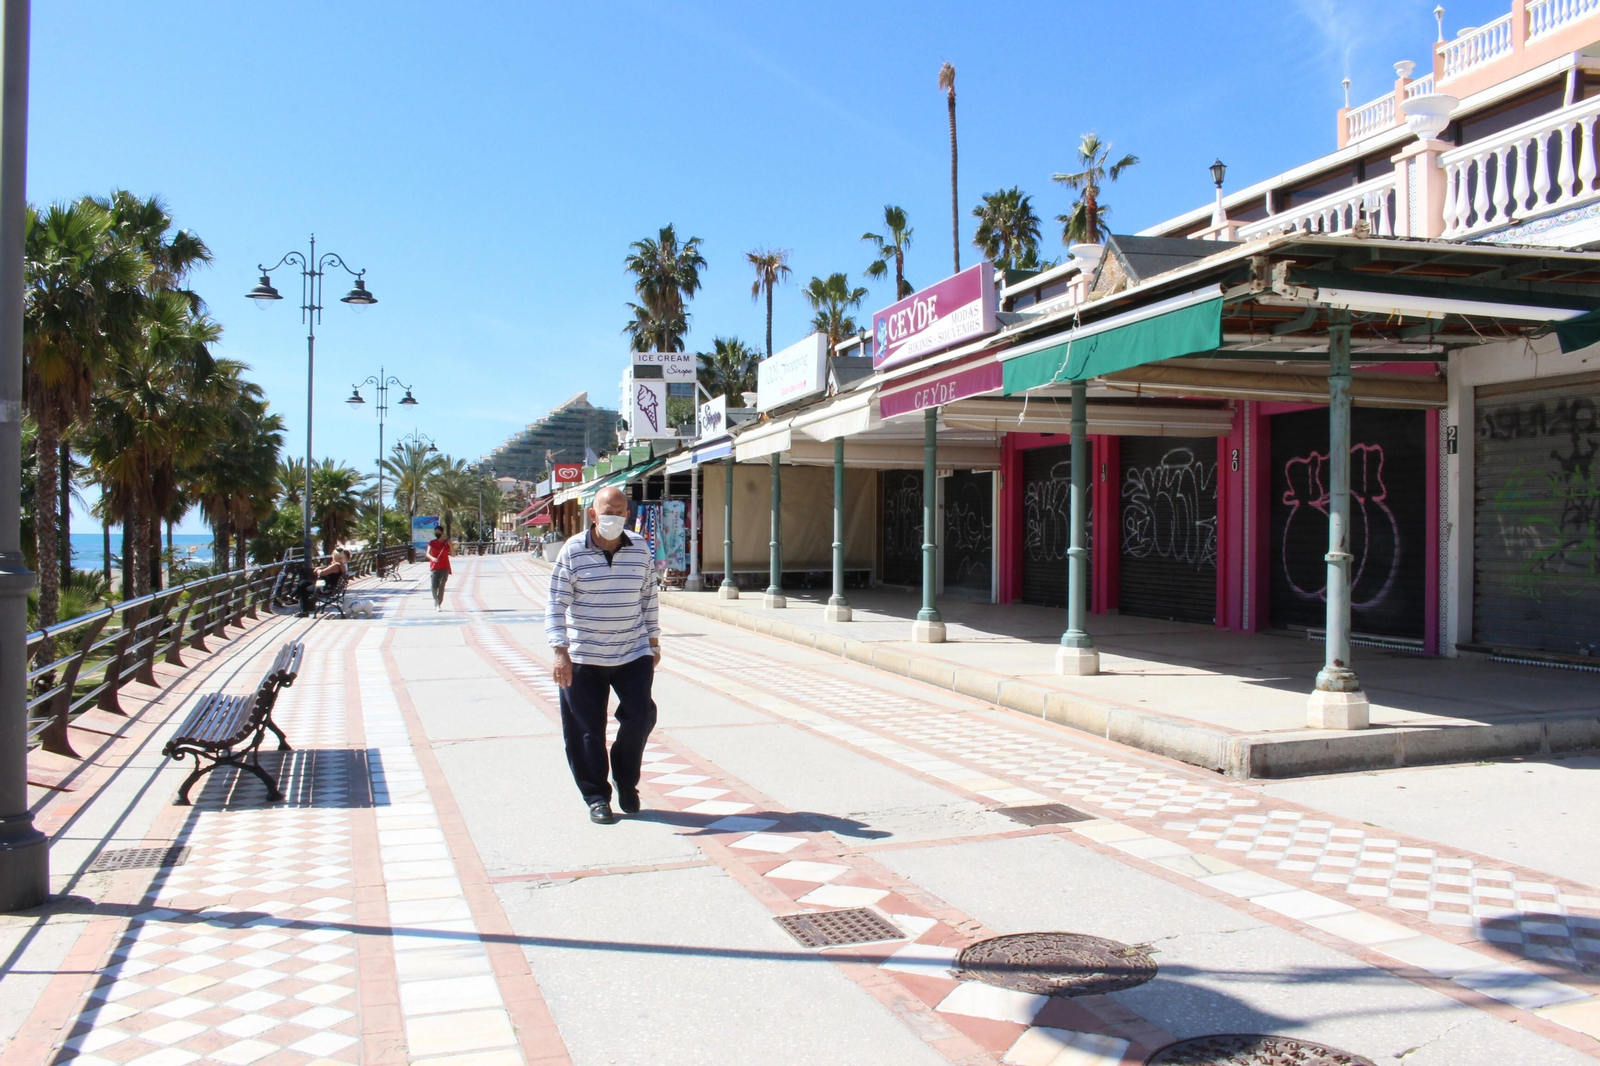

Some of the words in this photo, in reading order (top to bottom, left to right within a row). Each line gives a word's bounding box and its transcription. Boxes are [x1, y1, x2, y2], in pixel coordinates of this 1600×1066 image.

[888, 294, 939, 342] CEYDE
[951, 304, 979, 325] MODAS
[908, 336, 933, 354] BIKINIS
[938, 318, 981, 343] SOUVENIRS
[638, 354, 654, 362] ICE
[657, 354, 690, 362] CREAM
[666, 364, 693, 377] Sirope
[914, 381, 957, 408] CEYDE
[1448, 427, 1456, 454] 21
[1231, 450, 1238, 472] 20
